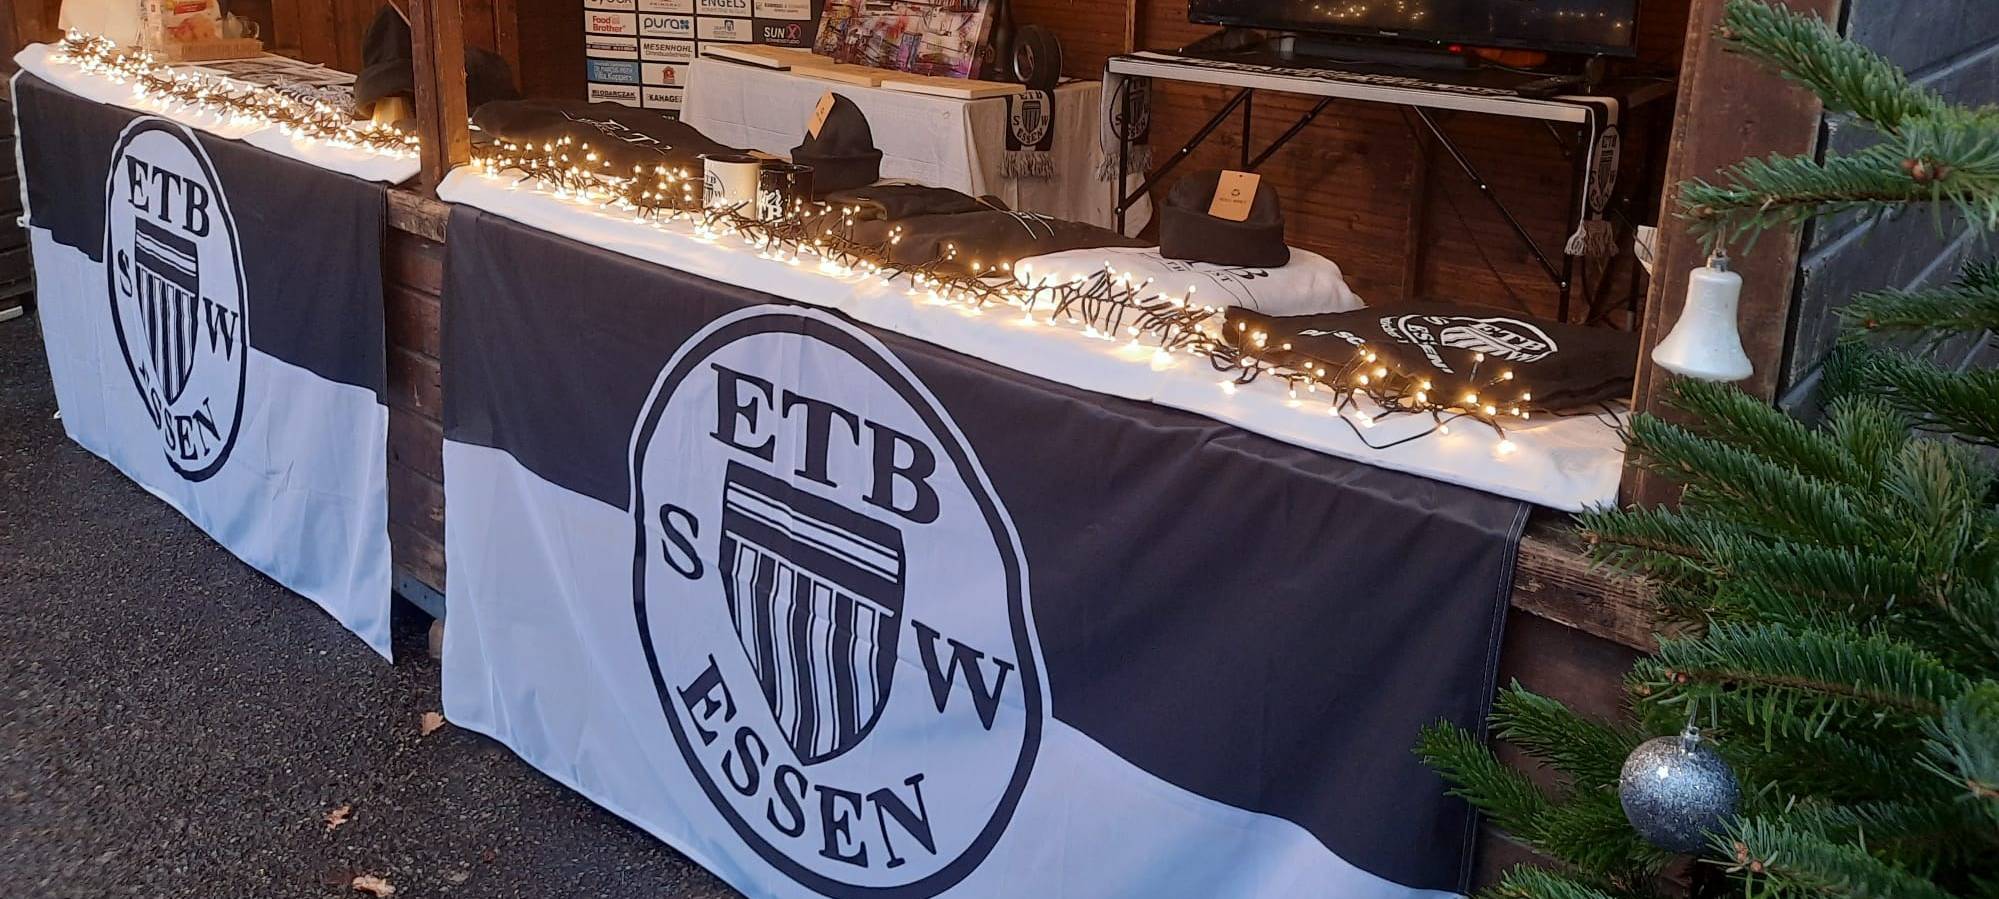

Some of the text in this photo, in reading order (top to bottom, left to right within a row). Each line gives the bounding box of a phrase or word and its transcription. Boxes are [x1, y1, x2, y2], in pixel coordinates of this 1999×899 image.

[701, 0, 746, 8] ENGELS
[593, 16, 611, 24] Food
[593, 24, 622, 32] Brother
[764, 26, 785, 39] SUN
[643, 43, 693, 53] MESENHOHL
[125, 154, 210, 237] ETB
[117, 249, 238, 361] S W
[1475, 323, 1547, 351] ETB
[710, 362, 941, 525] ETB
[659, 503, 1015, 731] S W
[677, 653, 937, 868] ESSEN
